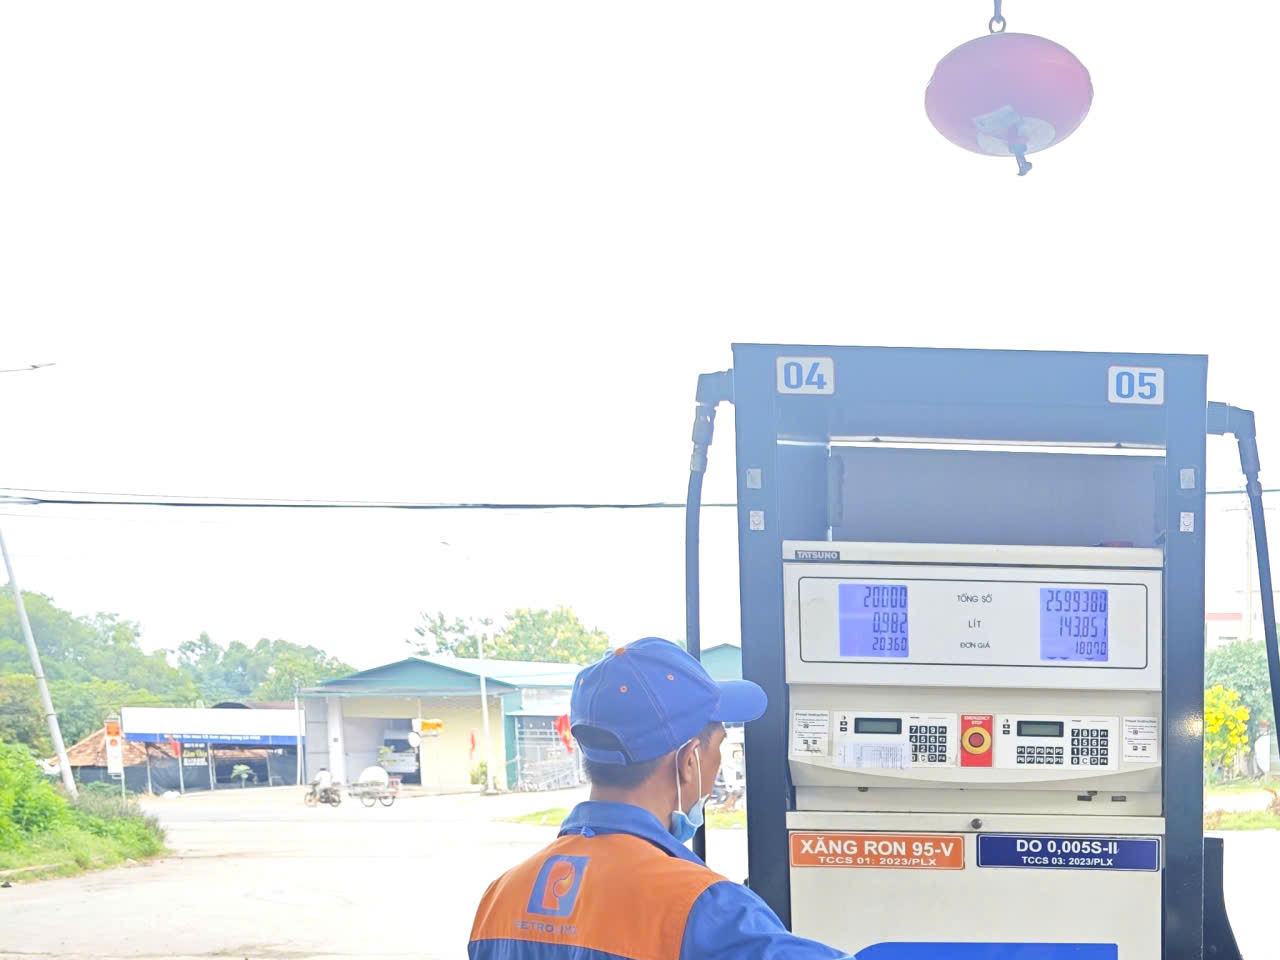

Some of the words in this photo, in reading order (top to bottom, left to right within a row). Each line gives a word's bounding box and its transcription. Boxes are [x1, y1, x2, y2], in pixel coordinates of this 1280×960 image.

[783, 362, 828, 390] 04
[1115, 371, 1157, 400] 05
[797, 551, 838, 560] TATSUNO
[863, 586, 908, 608] 20000
[1046, 590, 1107, 612] 2599380
[968, 618, 982, 628] LÍT
[872, 637, 908, 651] 20360
[1075, 641, 1107, 656] 18070
[800, 836, 857, 855] XĂNG
[864, 840, 906, 856] RON
[912, 842, 954, 857] 95-V
[1016, 839, 1043, 852] DO
[818, 856, 854, 864] TCCS
[857, 857, 875, 865] 01:
[879, 857, 937, 866] 2023/PLX
[1021, 856, 1049, 865] TCCS
[1051, 856, 1066, 865] 03:
[1068, 857, 1113, 866] 2023/PLX
